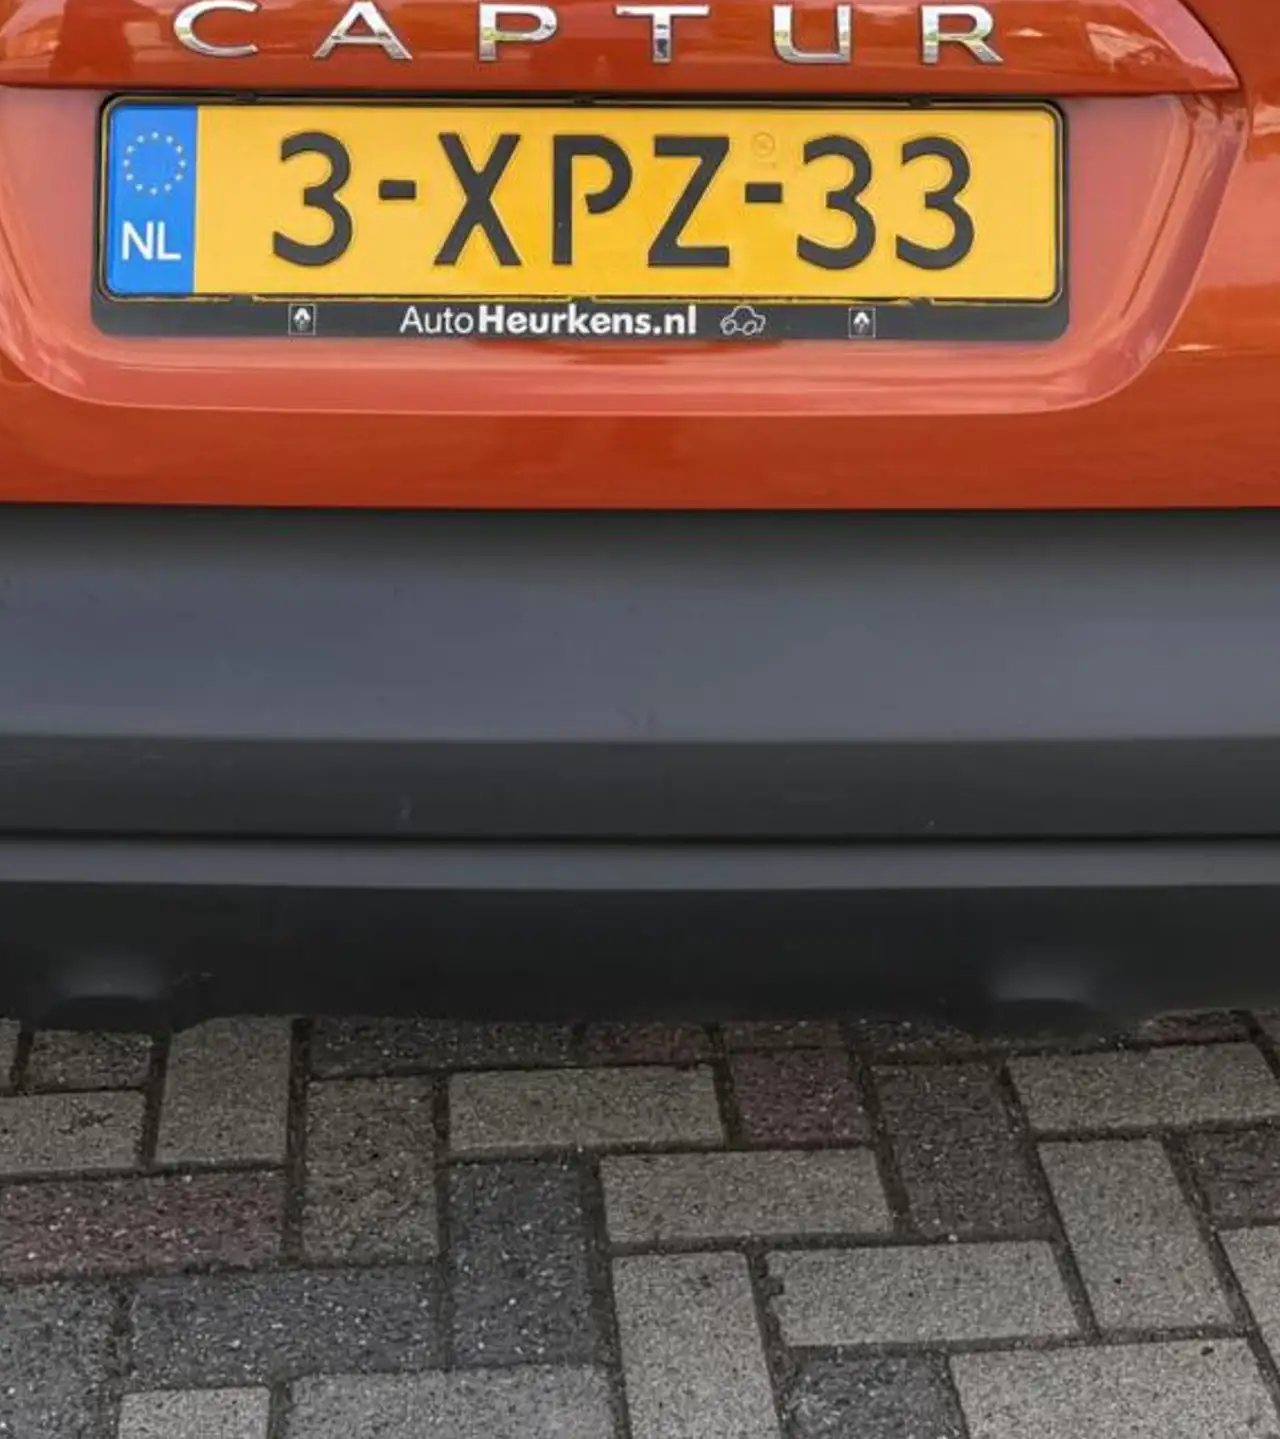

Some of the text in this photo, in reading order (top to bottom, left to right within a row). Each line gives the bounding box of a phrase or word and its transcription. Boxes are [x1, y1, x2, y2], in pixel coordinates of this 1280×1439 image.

[171, 0, 1004, 64] CAPTUR
[121, 131, 977, 271] NL 3-XPZ-33
